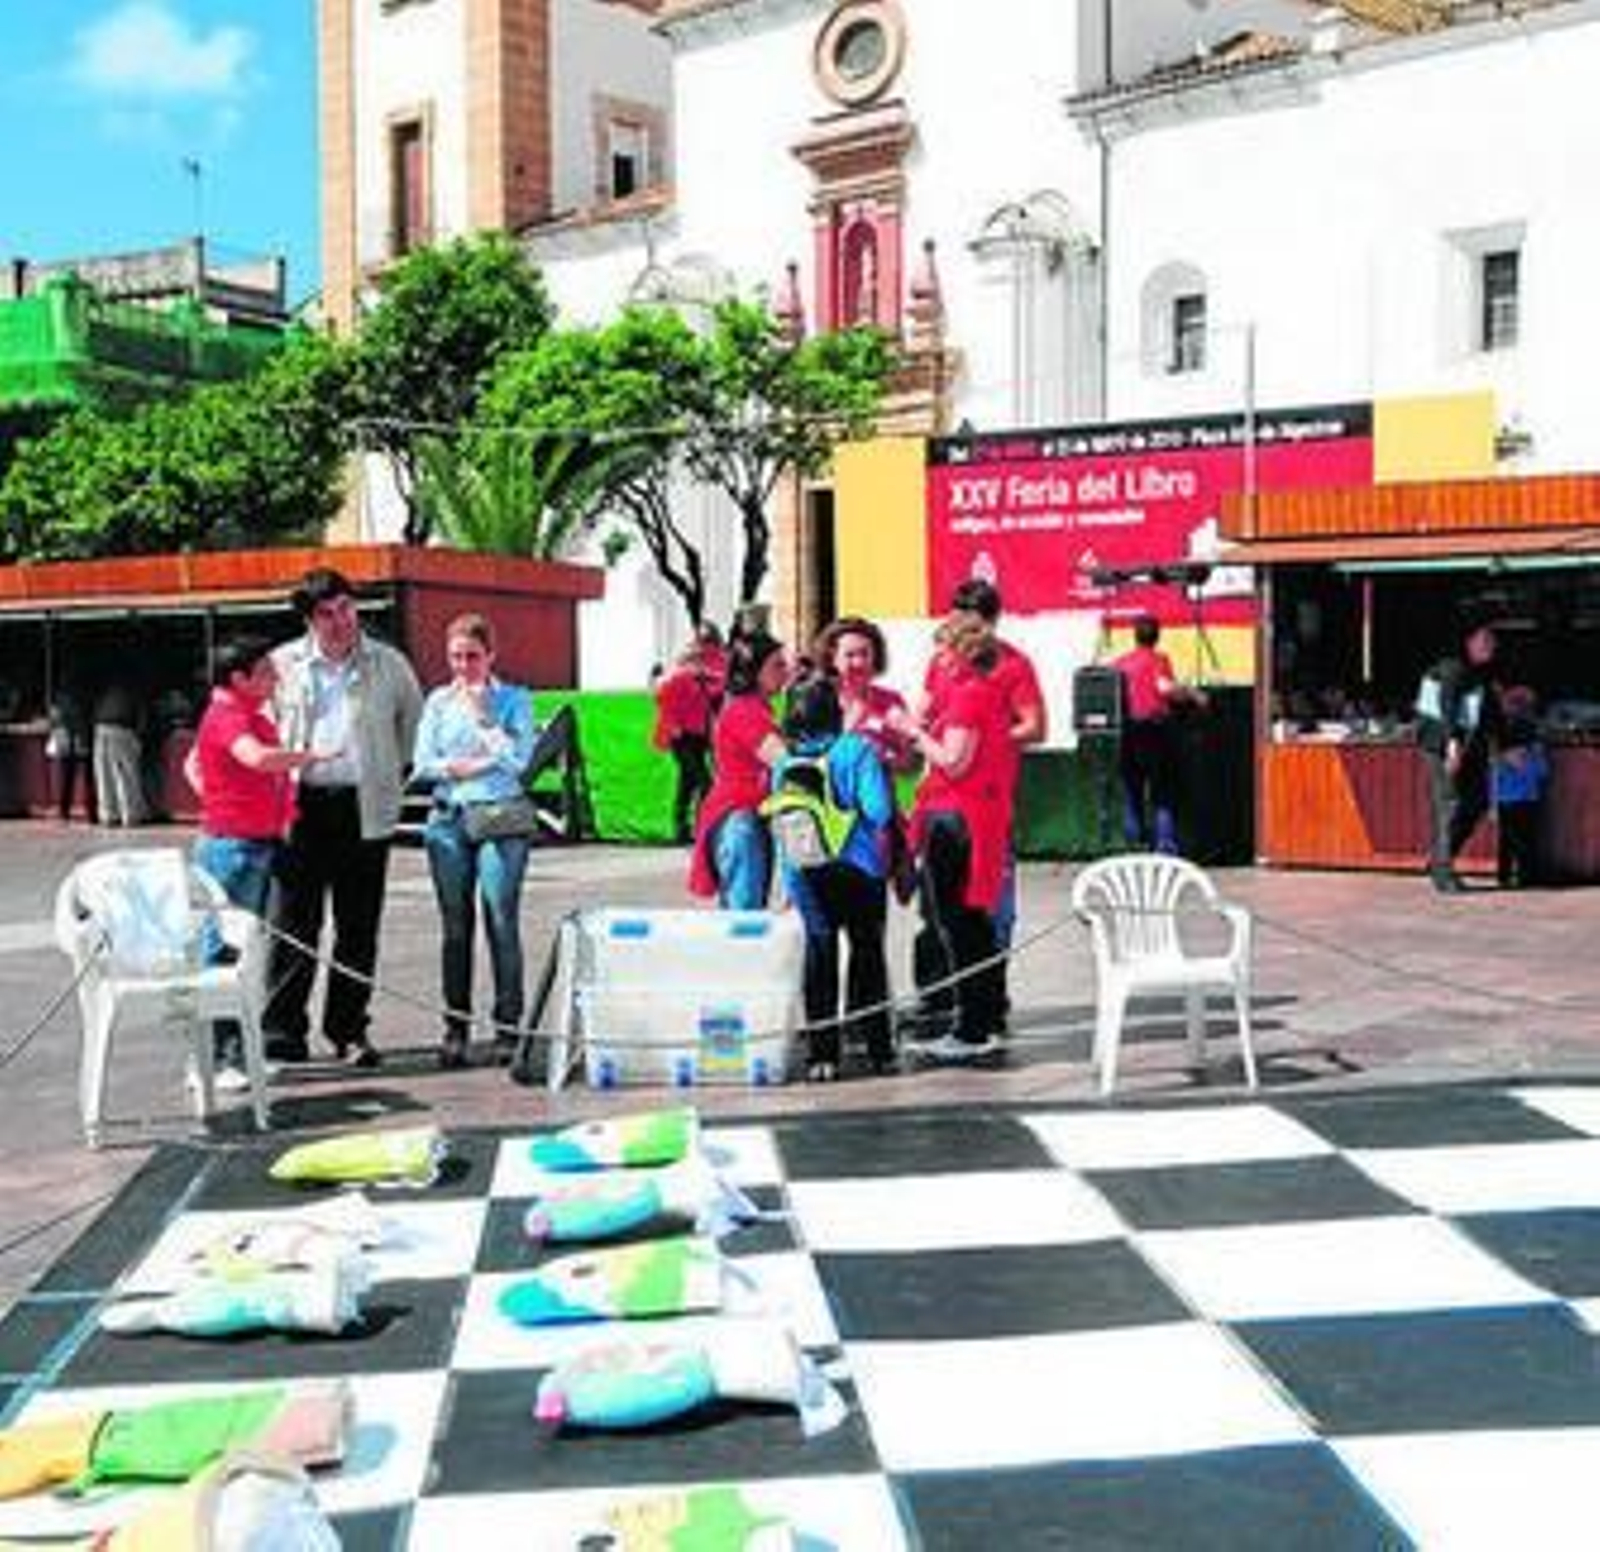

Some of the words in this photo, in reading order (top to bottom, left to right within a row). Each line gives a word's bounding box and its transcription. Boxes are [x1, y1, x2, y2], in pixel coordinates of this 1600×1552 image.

[948, 477, 1002, 510] XXV
[1006, 474, 1069, 507] Feria
[1077, 471, 1117, 502] del
[1125, 466, 1197, 500] Libro
